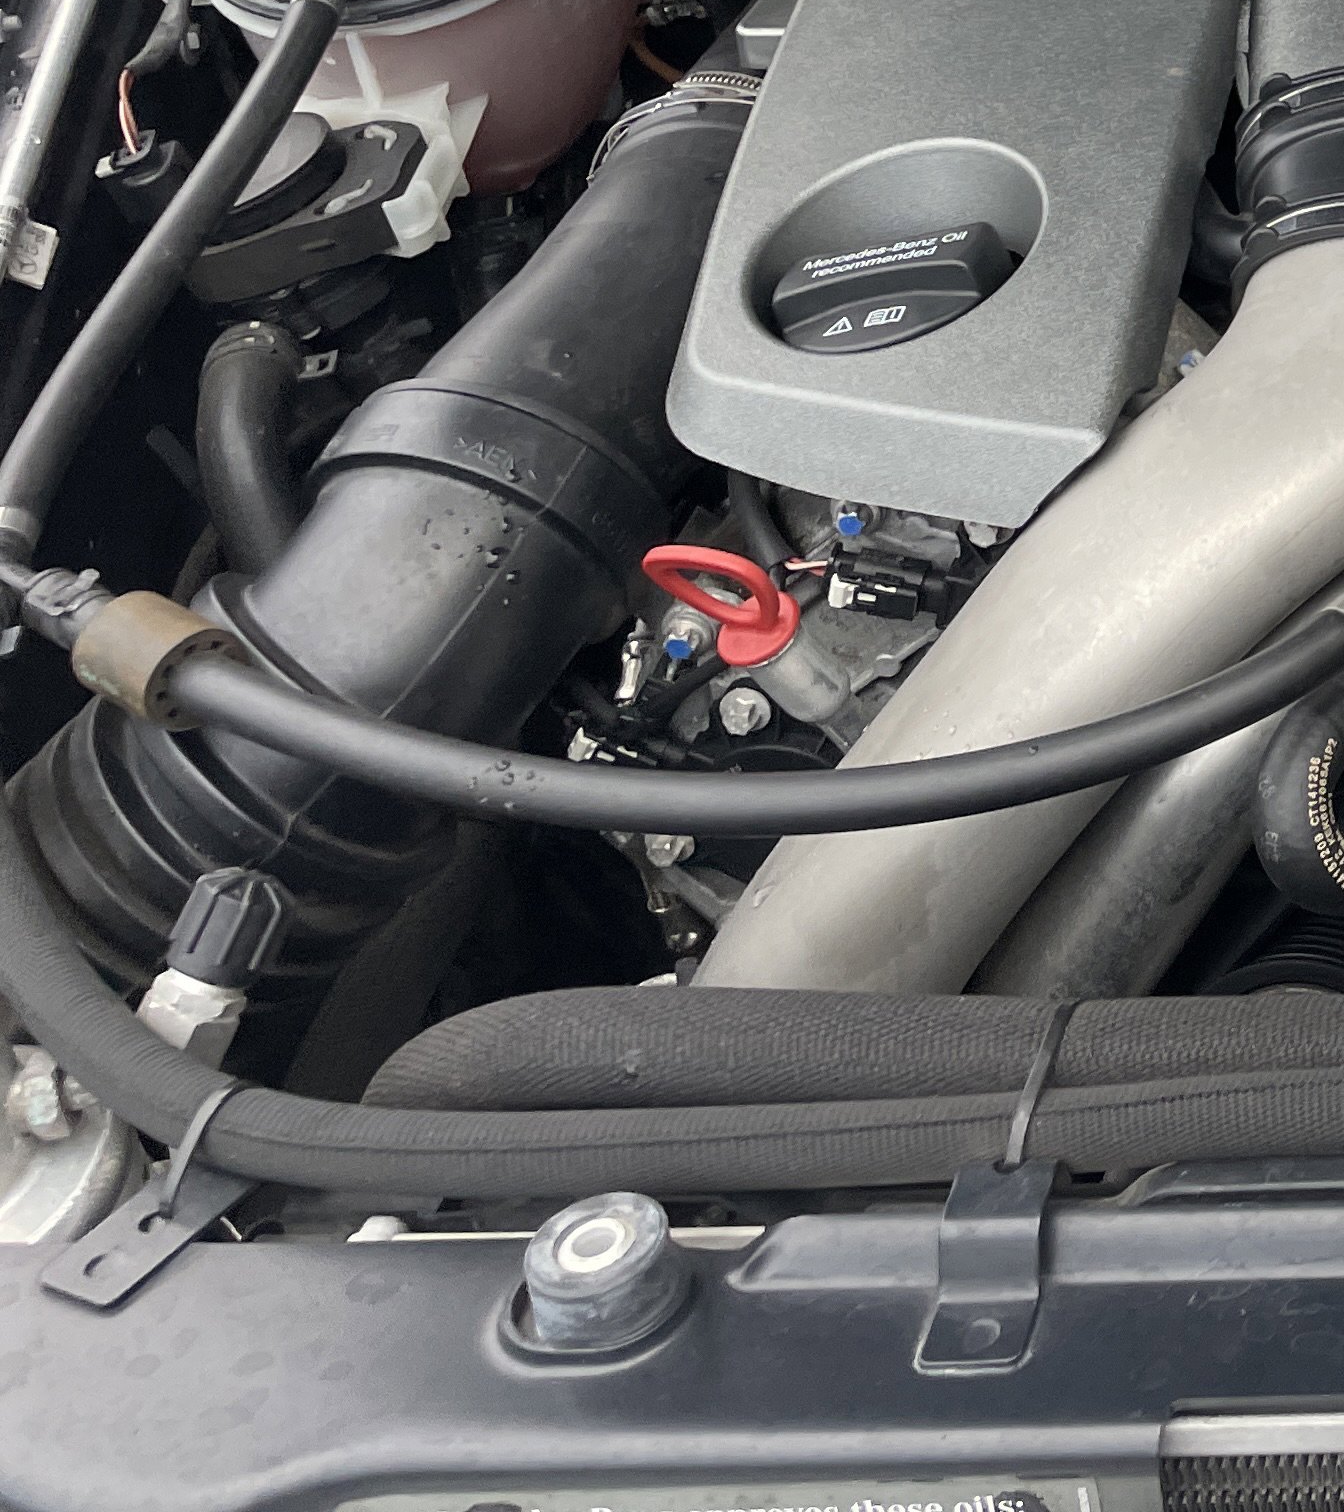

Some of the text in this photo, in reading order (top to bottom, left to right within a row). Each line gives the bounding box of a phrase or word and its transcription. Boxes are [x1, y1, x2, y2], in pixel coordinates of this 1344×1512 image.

[802, 230, 969, 272] Mercedes-Benz Oil
[811, 245, 938, 279] recommended
